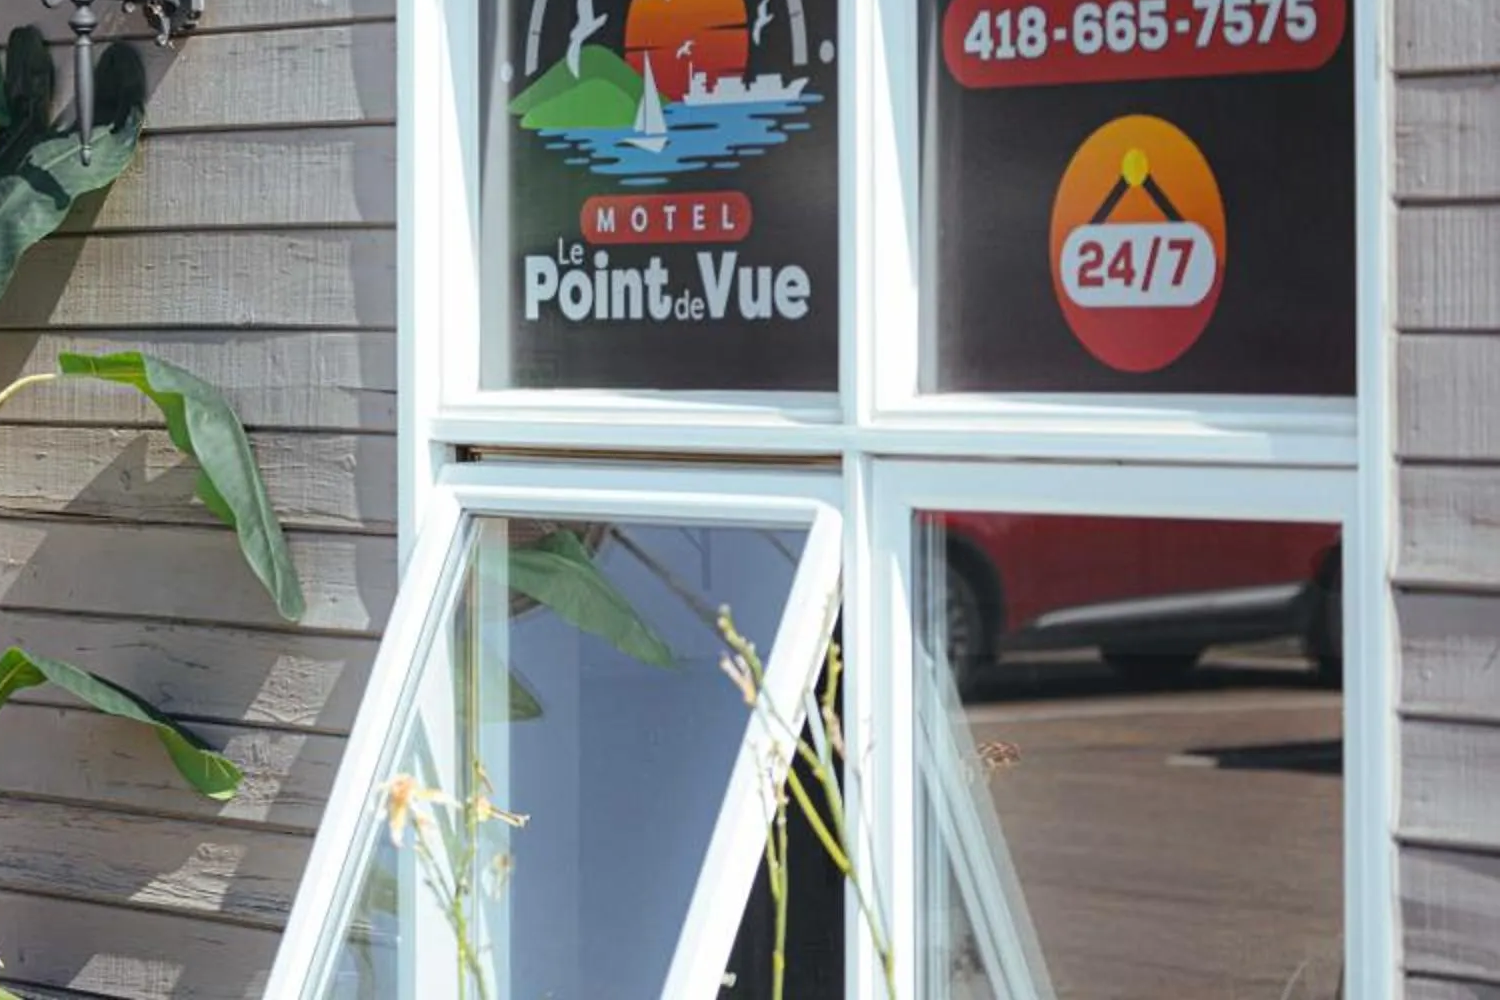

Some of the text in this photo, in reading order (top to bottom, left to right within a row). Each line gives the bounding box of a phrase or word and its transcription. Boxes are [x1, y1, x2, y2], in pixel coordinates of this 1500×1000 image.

[596, 204, 735, 233] MOTEL
[557, 237, 584, 265] Le
[1077, 236, 1194, 292] 24/7
[524, 250, 812, 322] Point de Vue
